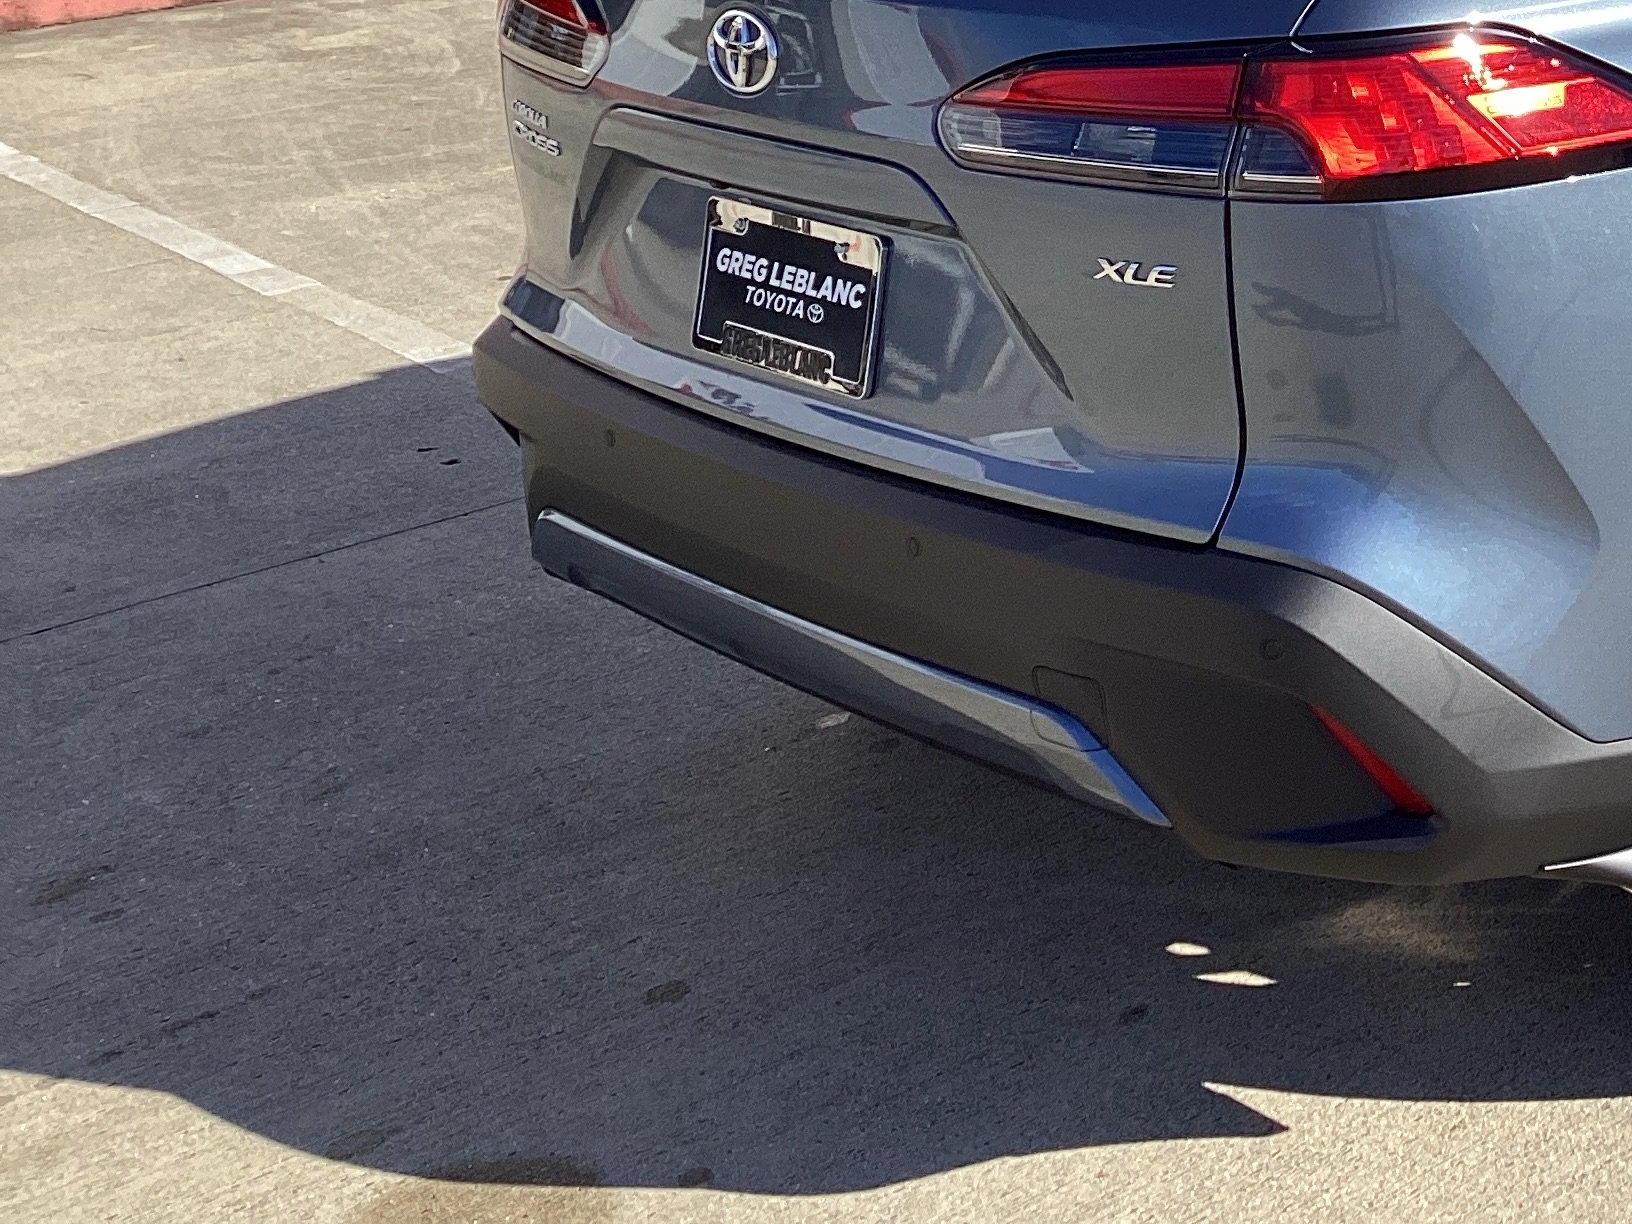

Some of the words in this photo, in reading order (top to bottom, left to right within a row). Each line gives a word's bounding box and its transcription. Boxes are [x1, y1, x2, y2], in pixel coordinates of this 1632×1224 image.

[716, 247, 769, 283] GREG
[768, 262, 866, 309] LEBLANC
[1092, 256, 1178, 289] XLE
[745, 285, 804, 319] TOYOTA
